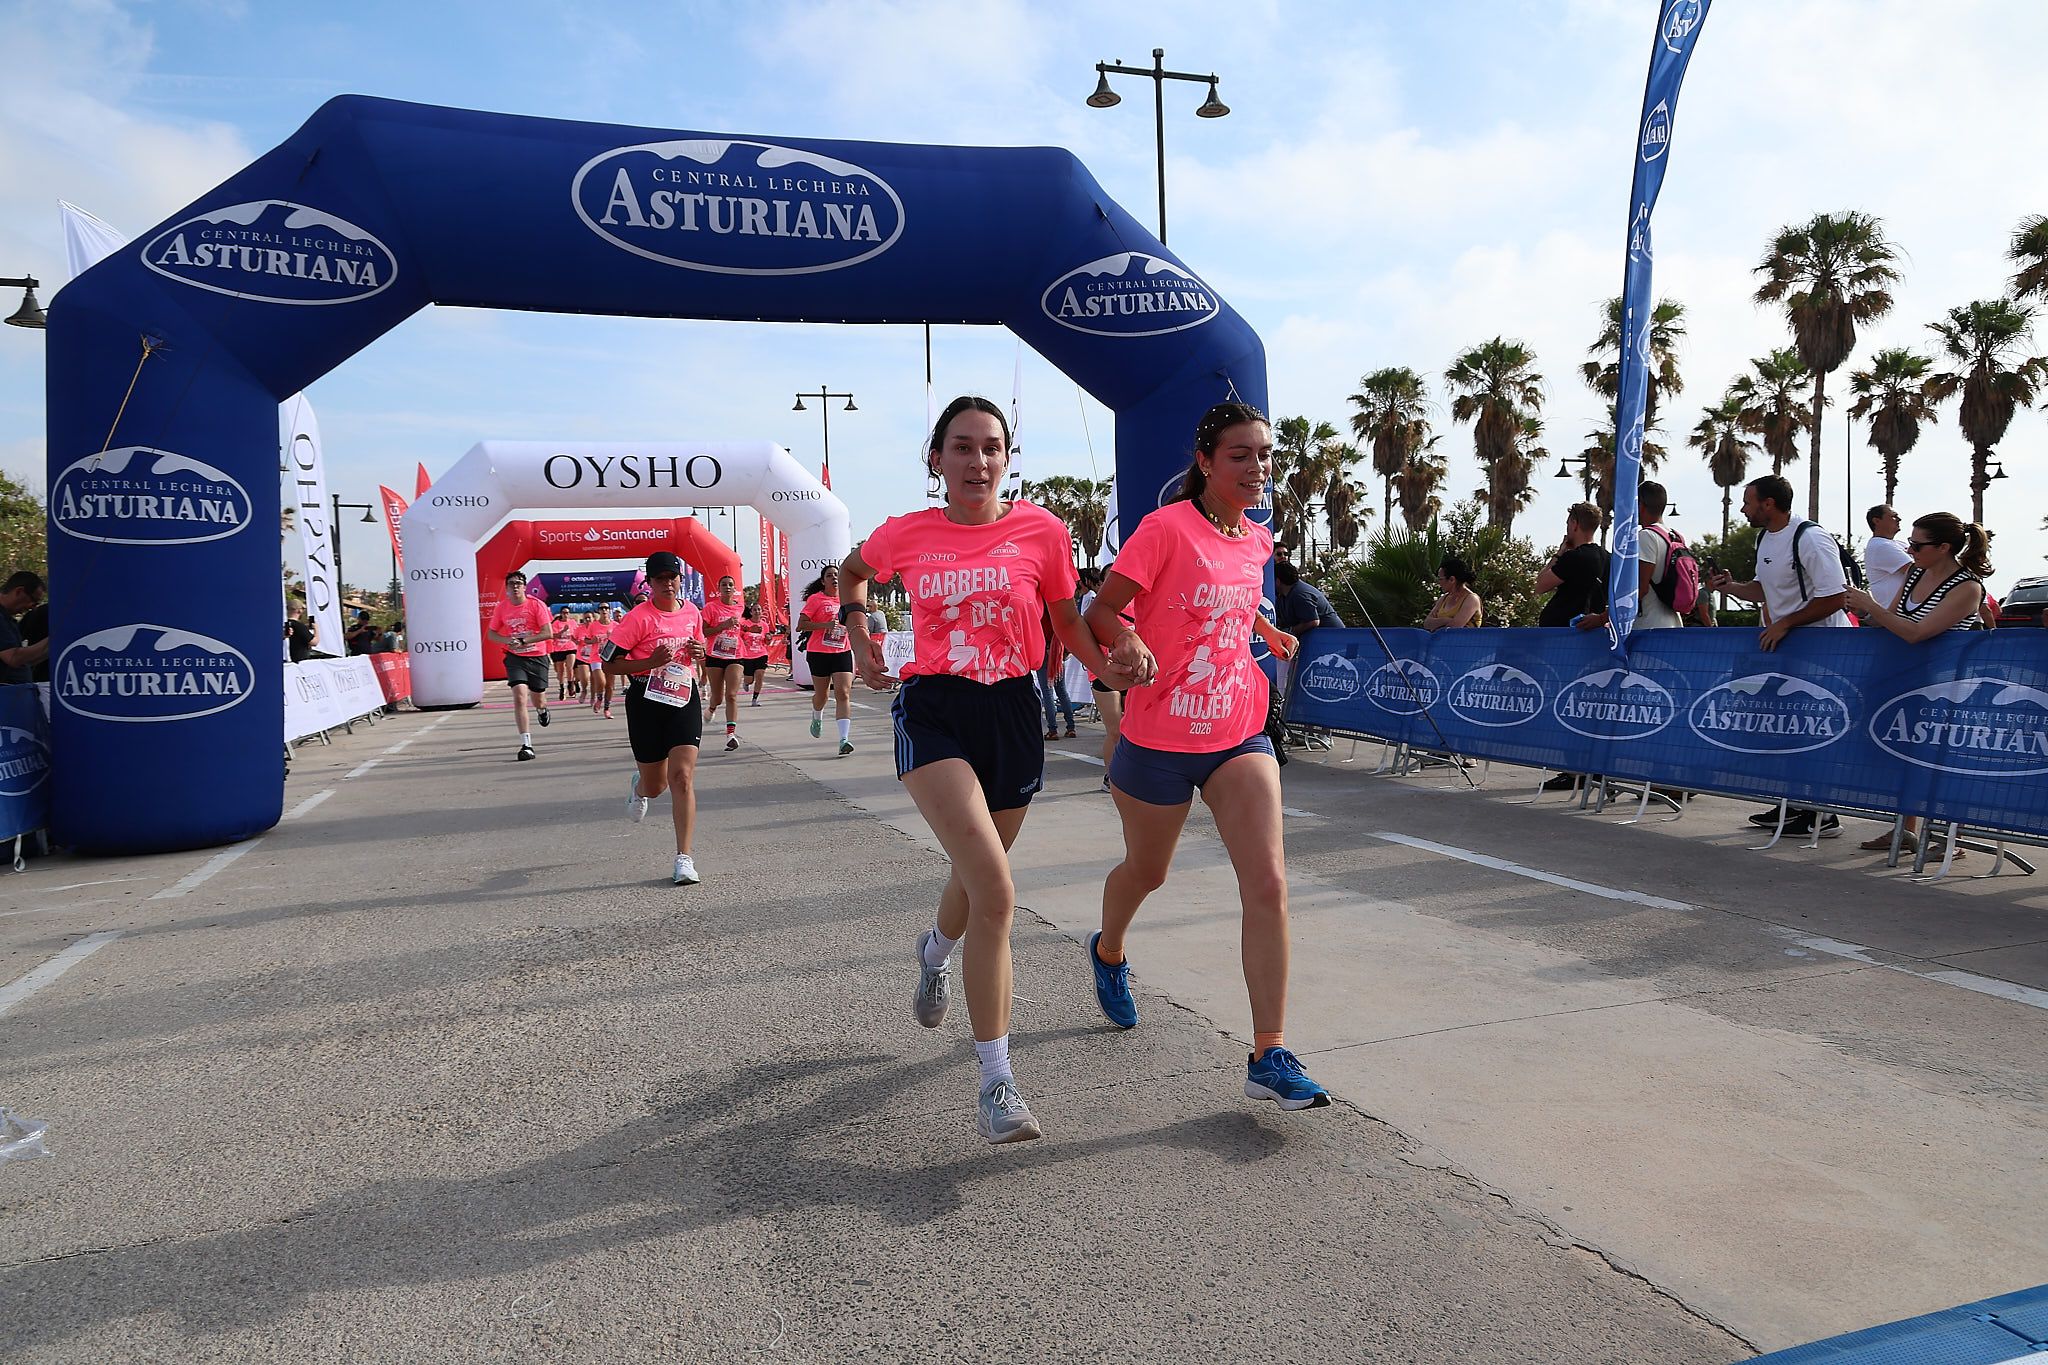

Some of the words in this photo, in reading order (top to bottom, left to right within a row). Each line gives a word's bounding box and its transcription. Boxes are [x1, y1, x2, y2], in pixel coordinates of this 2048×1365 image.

[653, 168, 757, 189] CENTRAL
[768, 177, 870, 196] LECHERA
[600, 168, 881, 241] ASTURIANA
[201, 228, 283, 244] CENTRAL
[291, 236, 375, 257] LECHERA
[156, 234, 378, 287] ASTURIANA
[1087, 280, 1147, 292] CENTRAL
[1152, 279, 1200, 290] LECHERA
[1057, 286, 1213, 318] ASTURIANA
[543, 454, 722, 489] OYSHO
[81, 480, 151, 490] CENTRAL
[160, 481, 233, 496] LECHERA
[772, 490, 821, 502] OYSHO
[59, 484, 240, 525] ASTURIANA
[432, 496, 489, 507] OYSHO
[539, 530, 582, 544] Sports
[602, 528, 669, 541] Santander
[919, 553, 956, 563] OYSHO
[1196, 557, 1224, 570] OYSHO
[411, 568, 464, 581] OYSHO
[919, 566, 1011, 599] CARRERA
[1193, 583, 1254, 612] CARRERA
[414, 640, 467, 654] OYSHO
[84, 658, 154, 667] CENTRAL
[162, 657, 236, 668] LECHERA
[62, 661, 242, 696] ASTURIANA
[664, 680, 680, 690] 016
[1453, 684, 1534, 713] ASTURIANA
[1581, 690, 1617, 700] CENTRAL
[1725, 699, 1775, 710] CENTRAL
[1779, 701, 1834, 712] LECHERA
[1169, 693, 1232, 719] MUJER
[1560, 692, 1662, 724] ASTURIANA
[1920, 707, 1988, 720] CENTRAL
[1189, 722, 1212, 735] 2026
[1698, 700, 1834, 737] ASTURIANA
[1881, 708, 2048, 758] ASTURIAN
